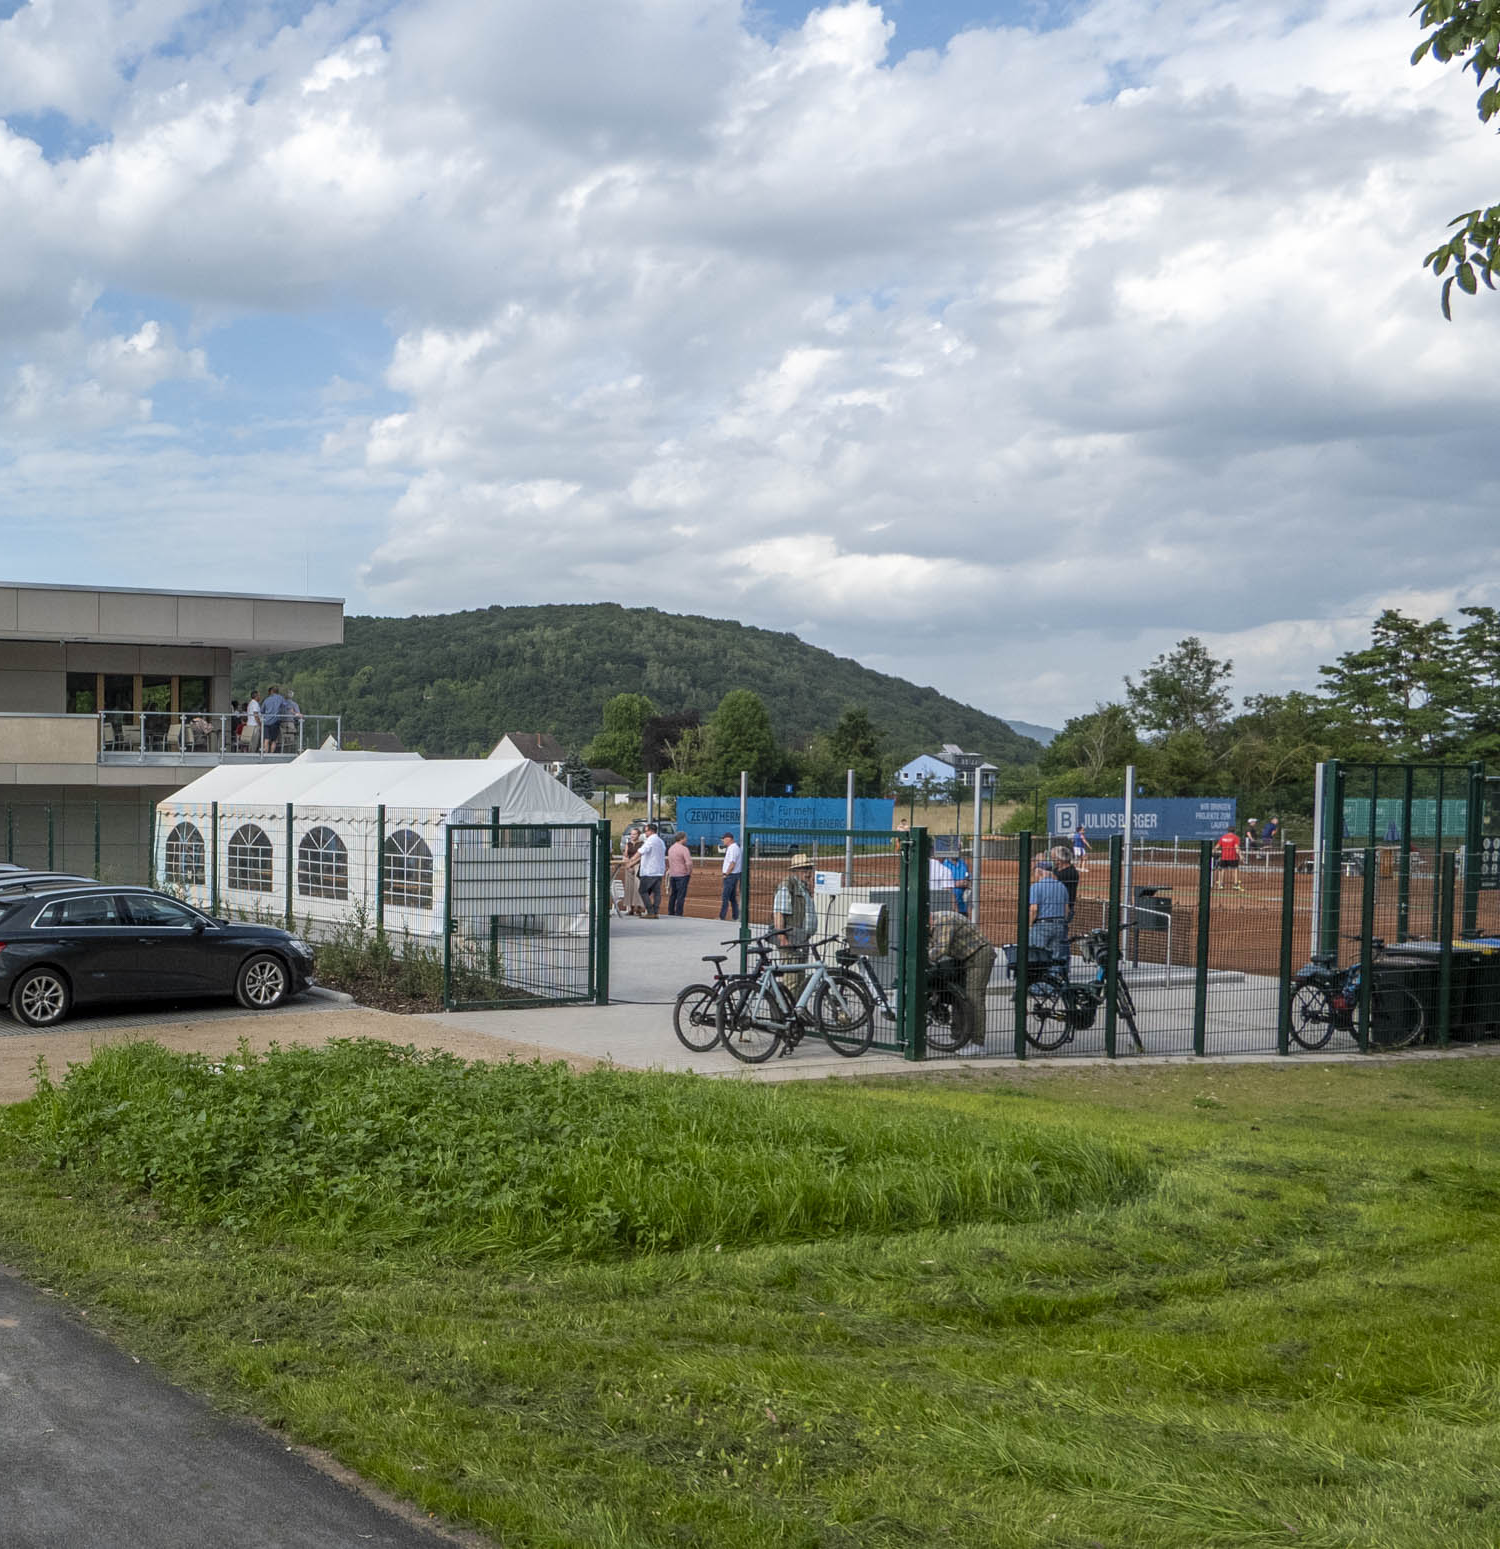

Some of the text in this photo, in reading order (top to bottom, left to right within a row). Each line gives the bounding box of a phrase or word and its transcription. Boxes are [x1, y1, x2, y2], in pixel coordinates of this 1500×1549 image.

[1061, 811, 1072, 829] B
[1082, 813, 1157, 828] JULIUS BRGER
